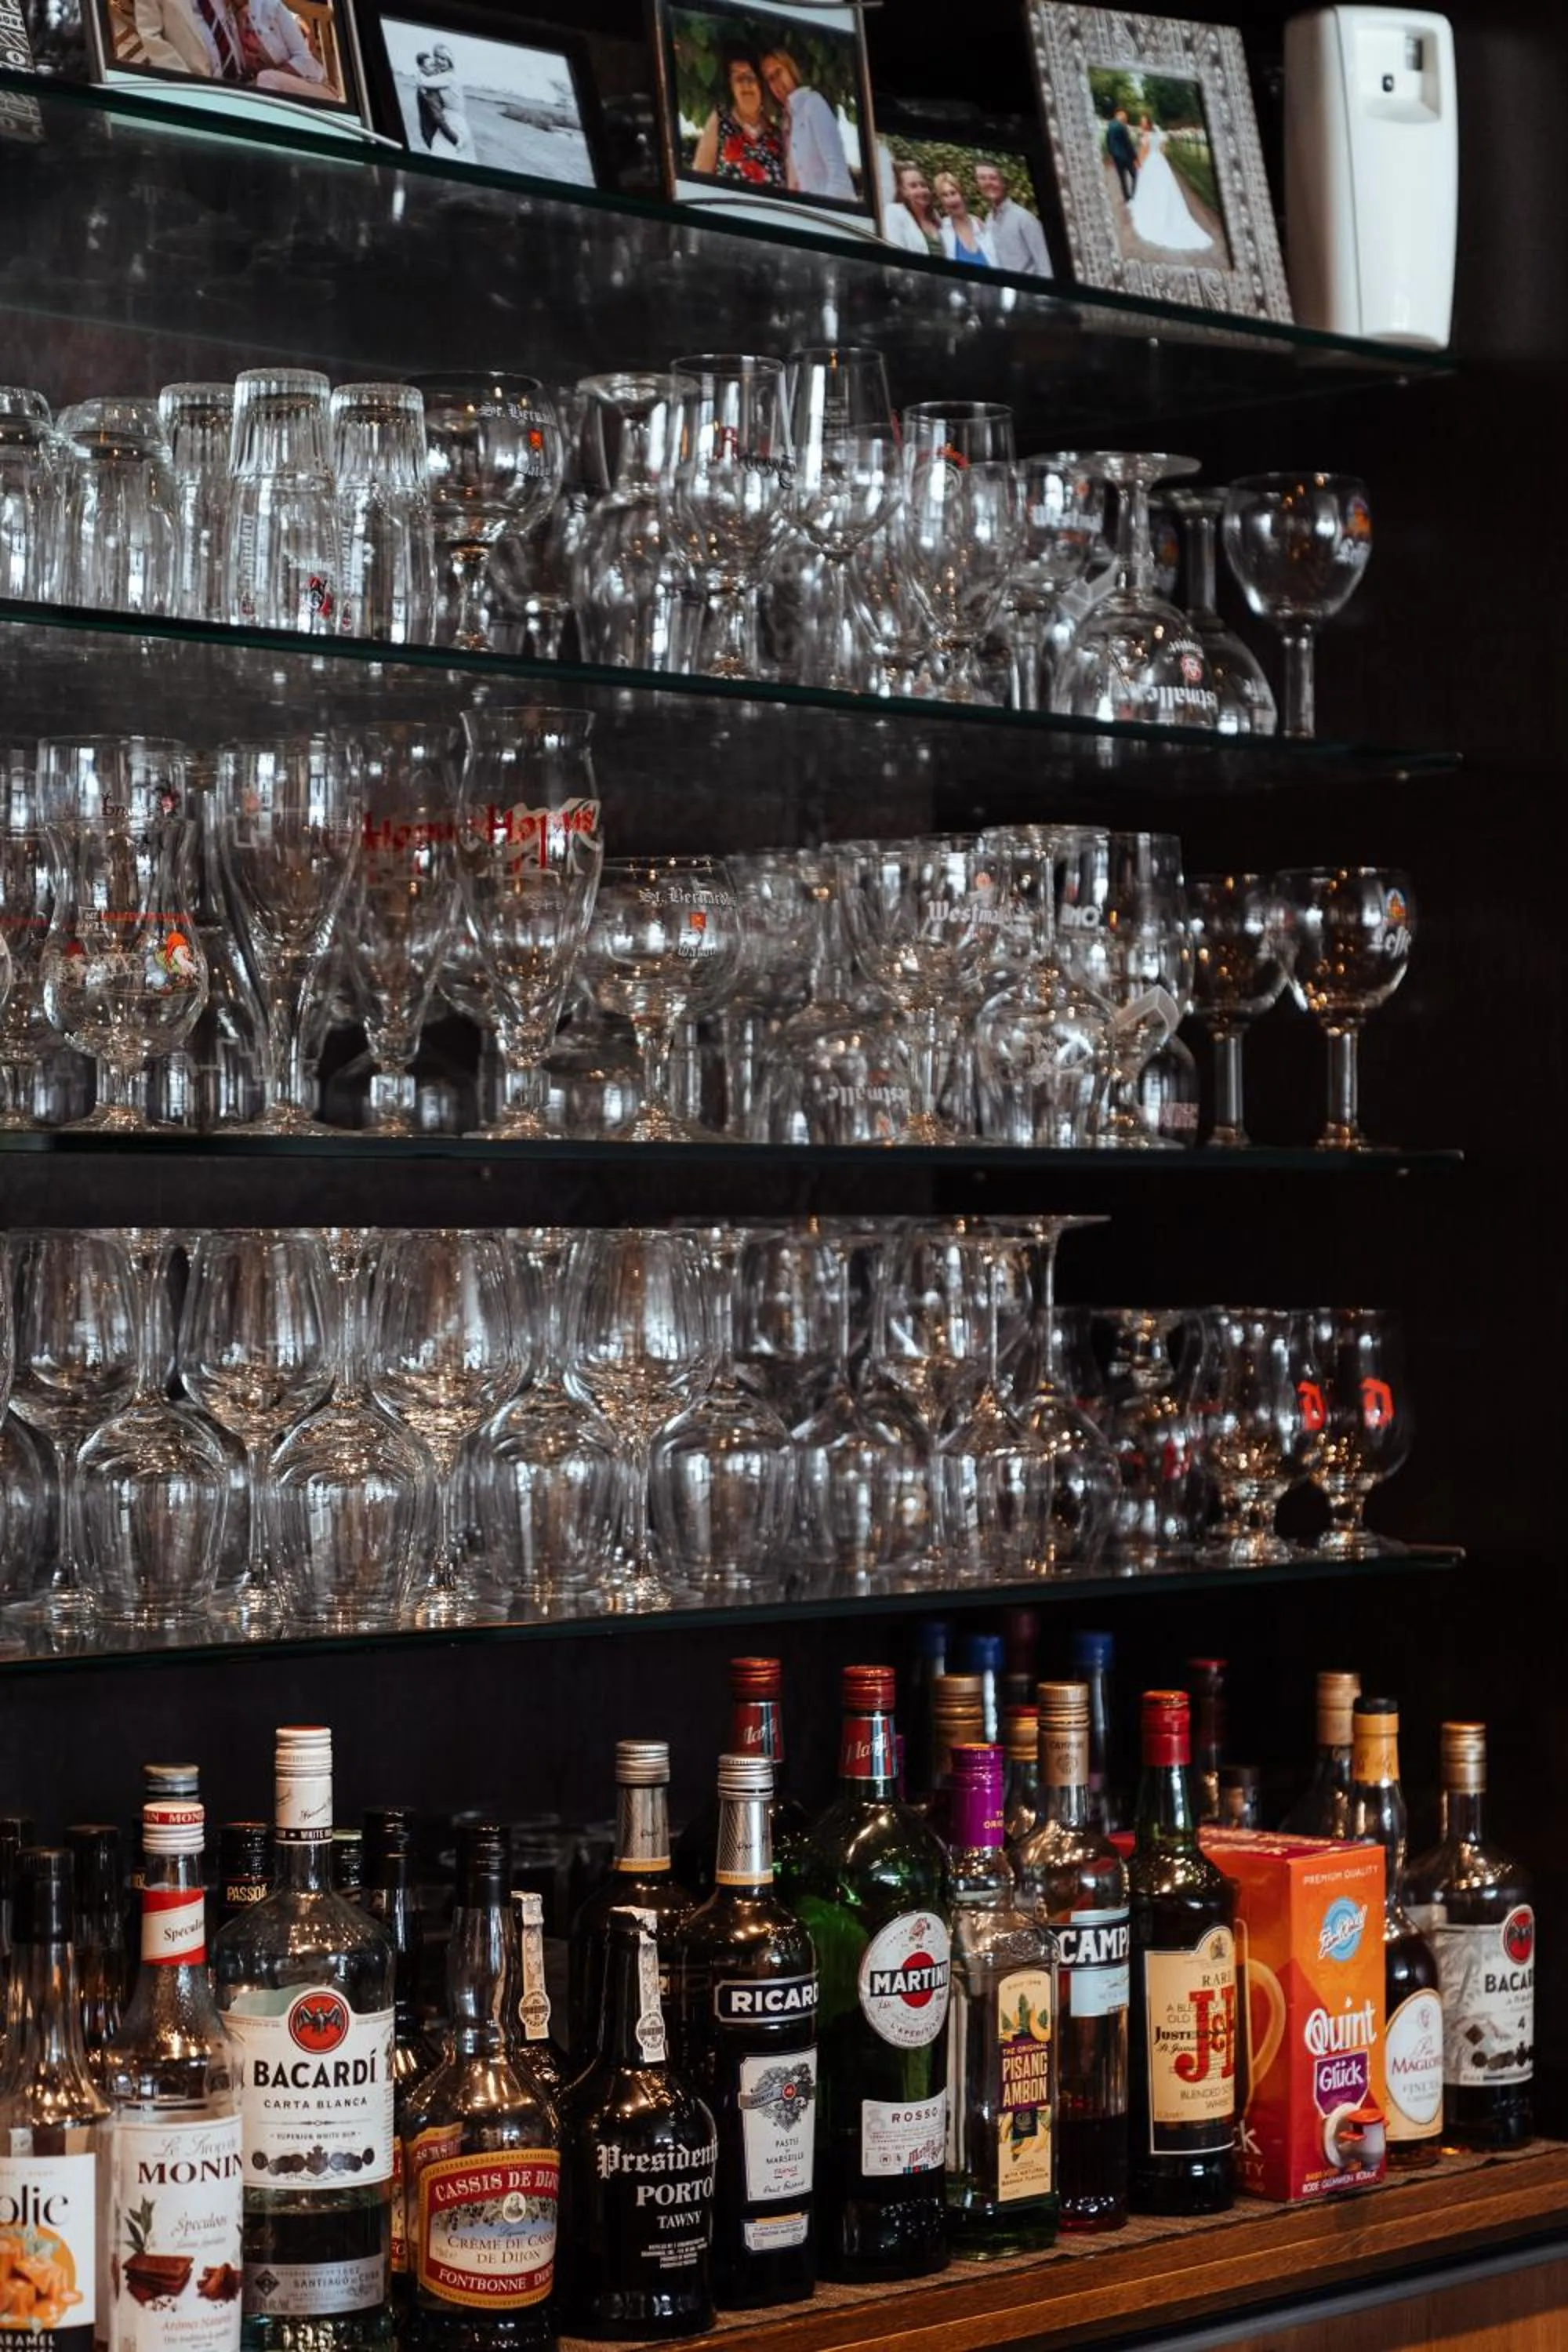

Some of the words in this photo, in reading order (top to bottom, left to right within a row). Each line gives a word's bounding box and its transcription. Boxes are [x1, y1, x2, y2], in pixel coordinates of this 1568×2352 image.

[1305, 1996, 1378, 2056] Quint
[253, 2047, 377, 2089] BACARDÍ
[1002, 2051, 1048, 2082] PISANG
[1319, 2060, 1364, 2092] Glück
[263, 2099, 310, 2109] CARTA
[317, 2096, 368, 2109] BLANCA
[1002, 2076, 1047, 2108] AMBON
[891, 2107, 939, 2124] ROSSO
[434, 2172, 503, 2202] CASSIS
[507, 2170, 532, 2189] DE
[635, 2176, 713, 2206] PORTO
[656, 2209, 702, 2230] TAWNY
[477, 2251, 496, 2265] DE
[437, 2267, 528, 2292] FONTBONNE
